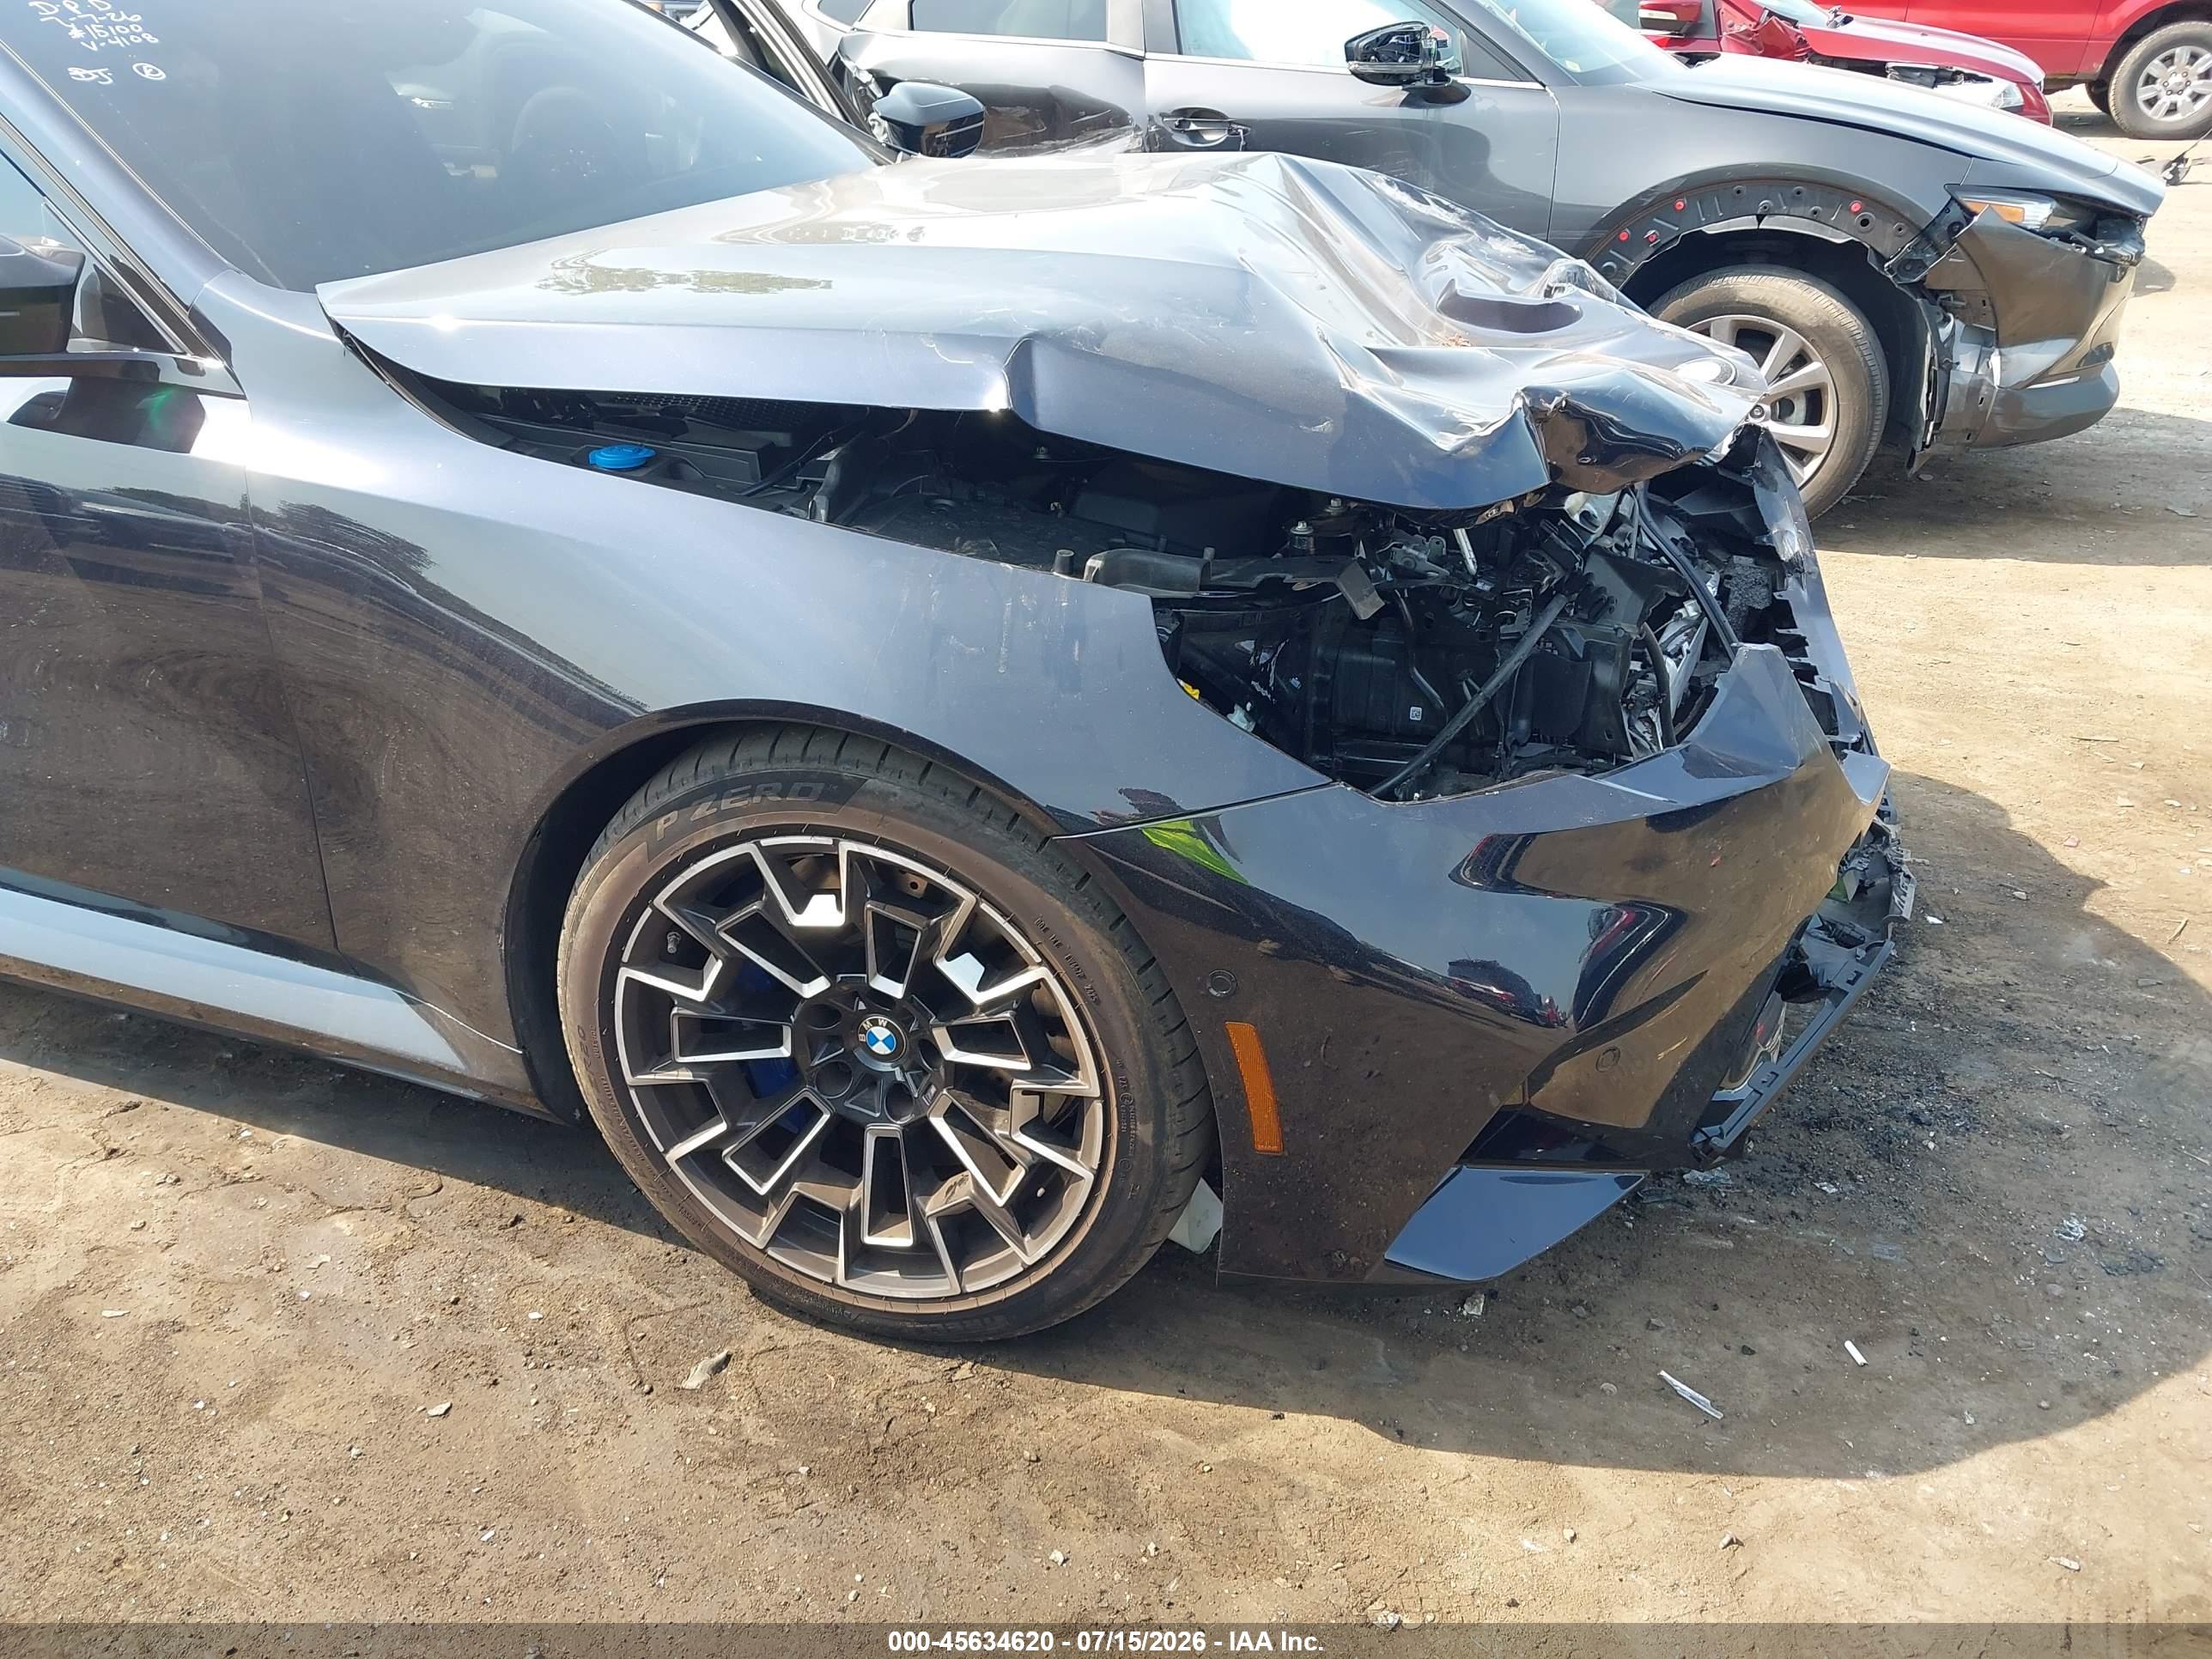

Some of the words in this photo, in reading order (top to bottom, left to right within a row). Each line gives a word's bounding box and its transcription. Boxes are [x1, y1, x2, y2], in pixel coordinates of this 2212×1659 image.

[656, 810, 678, 841] P
[690, 781, 825, 822] ZERO
[859, 1018, 888, 1042] BMW
